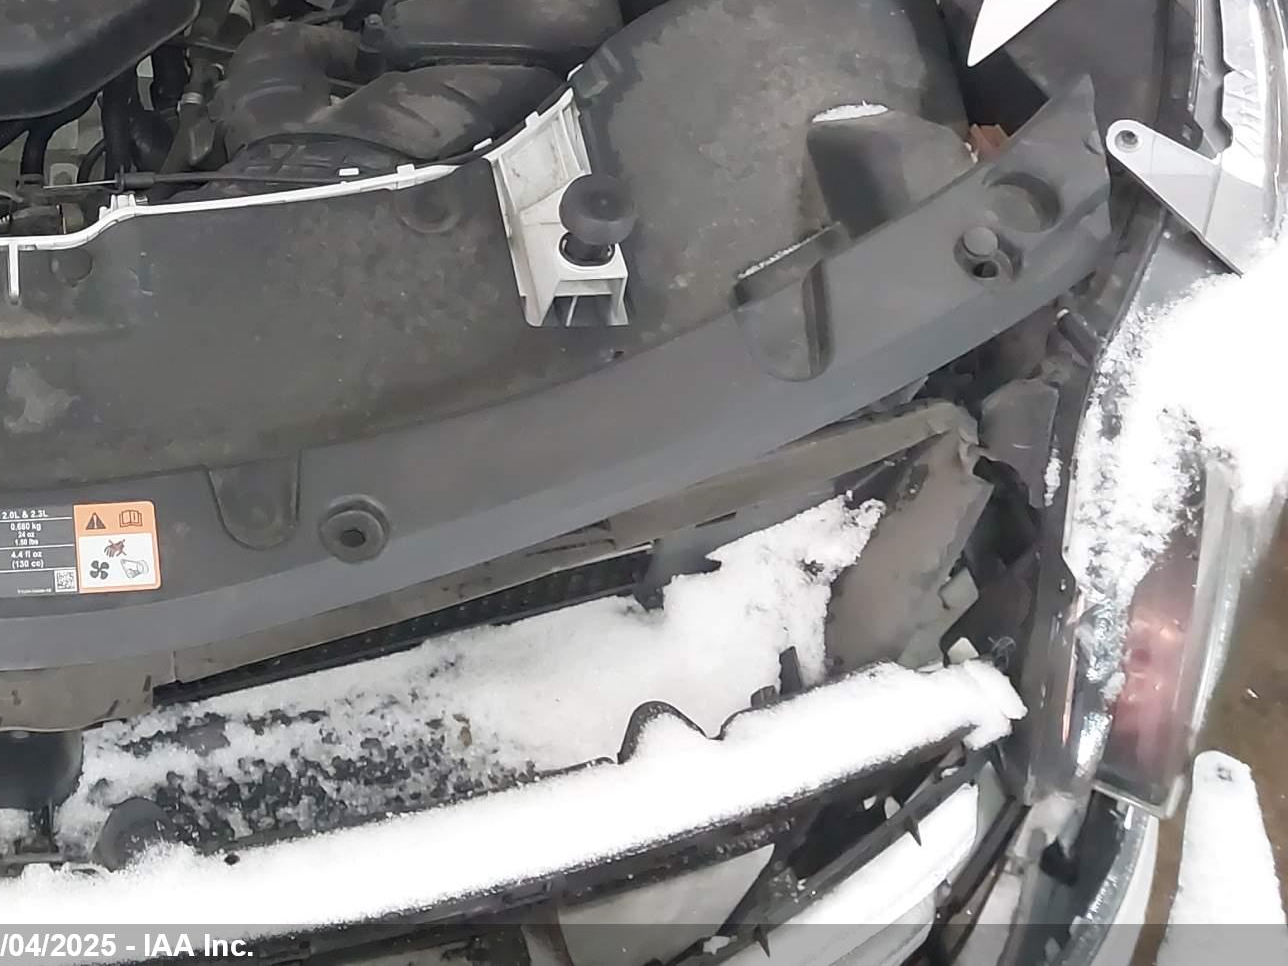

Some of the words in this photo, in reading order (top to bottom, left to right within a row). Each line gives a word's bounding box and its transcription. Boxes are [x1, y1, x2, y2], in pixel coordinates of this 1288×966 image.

[1, 510, 20, 520] 2.0L
[22, 510, 29, 519] &
[30, 509, 49, 518] 2.3L
[10, 522, 30, 531] 0.680
[31, 521, 42, 532] kg
[14, 538, 28, 546] 1.50
[28, 538, 39, 546] lbs
[11, 550, 24, 558] 4.4
[25, 550, 31, 558] fl
[12, 560, 29, 570] (130
[30, 559, 44, 569] cc)
